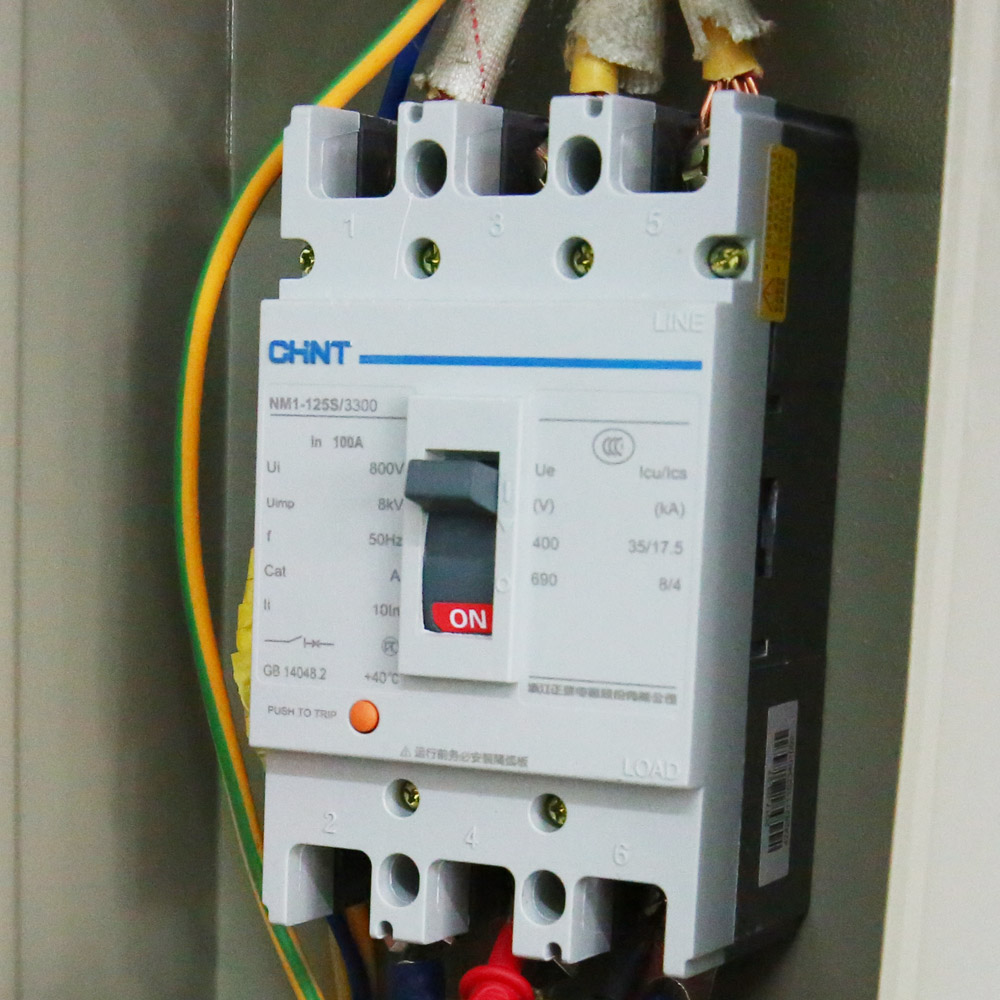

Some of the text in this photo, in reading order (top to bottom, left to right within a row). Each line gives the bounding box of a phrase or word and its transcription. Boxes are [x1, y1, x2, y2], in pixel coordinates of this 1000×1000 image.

[652, 311, 705, 334] LINE
[269, 397, 378, 413] NM1-125S/3300
[333, 436, 364, 449] 100A
[266, 461, 280, 473] Ui
[369, 461, 405, 475] 800V
[535, 463, 556, 477] Ue
[377, 497, 404, 511] 8kV
[533, 498, 555, 515] (V)
[654, 502, 686, 519] (kA)
[369, 533, 403, 547] 50Hz
[532, 536, 560, 551] 400
[628, 539, 684, 555] 35/17.5
[264, 564, 286, 577] Cat
[390, 569, 400, 582] A
[531, 572, 558, 587] 690
[658, 577, 682, 592] 8/4
[450, 609, 487, 629] ON
[263, 665, 327, 680] GB 14048.2
[267, 705, 337, 719] PUSH TO TRIP
[623, 757, 679, 781] LOAD
